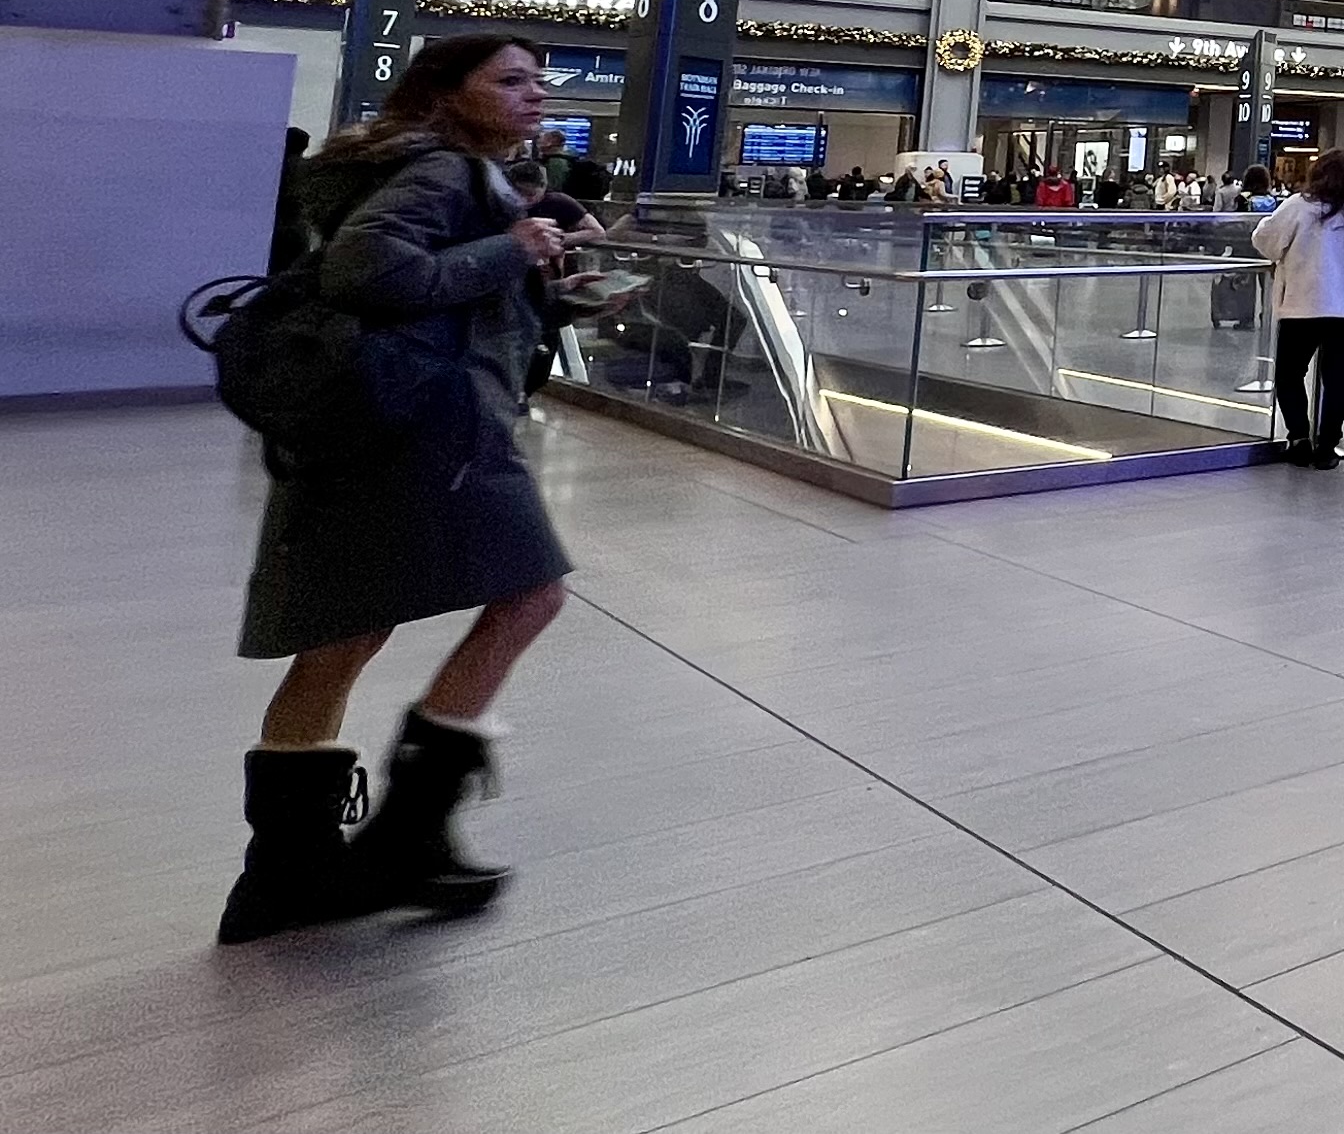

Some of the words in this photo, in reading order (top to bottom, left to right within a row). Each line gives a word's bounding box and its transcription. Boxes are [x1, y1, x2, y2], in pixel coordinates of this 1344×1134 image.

[381, 9, 399, 36] 7
[1192, 38, 1222, 57] 9th
[374, 55, 393, 82] 8
[733, 79, 786, 94] Baggage
[791, 82, 844, 95] Check-in
[1241, 70, 1250, 90] 9
[1264, 72, 1271, 90] 9
[1238, 103, 1250, 122] 10
